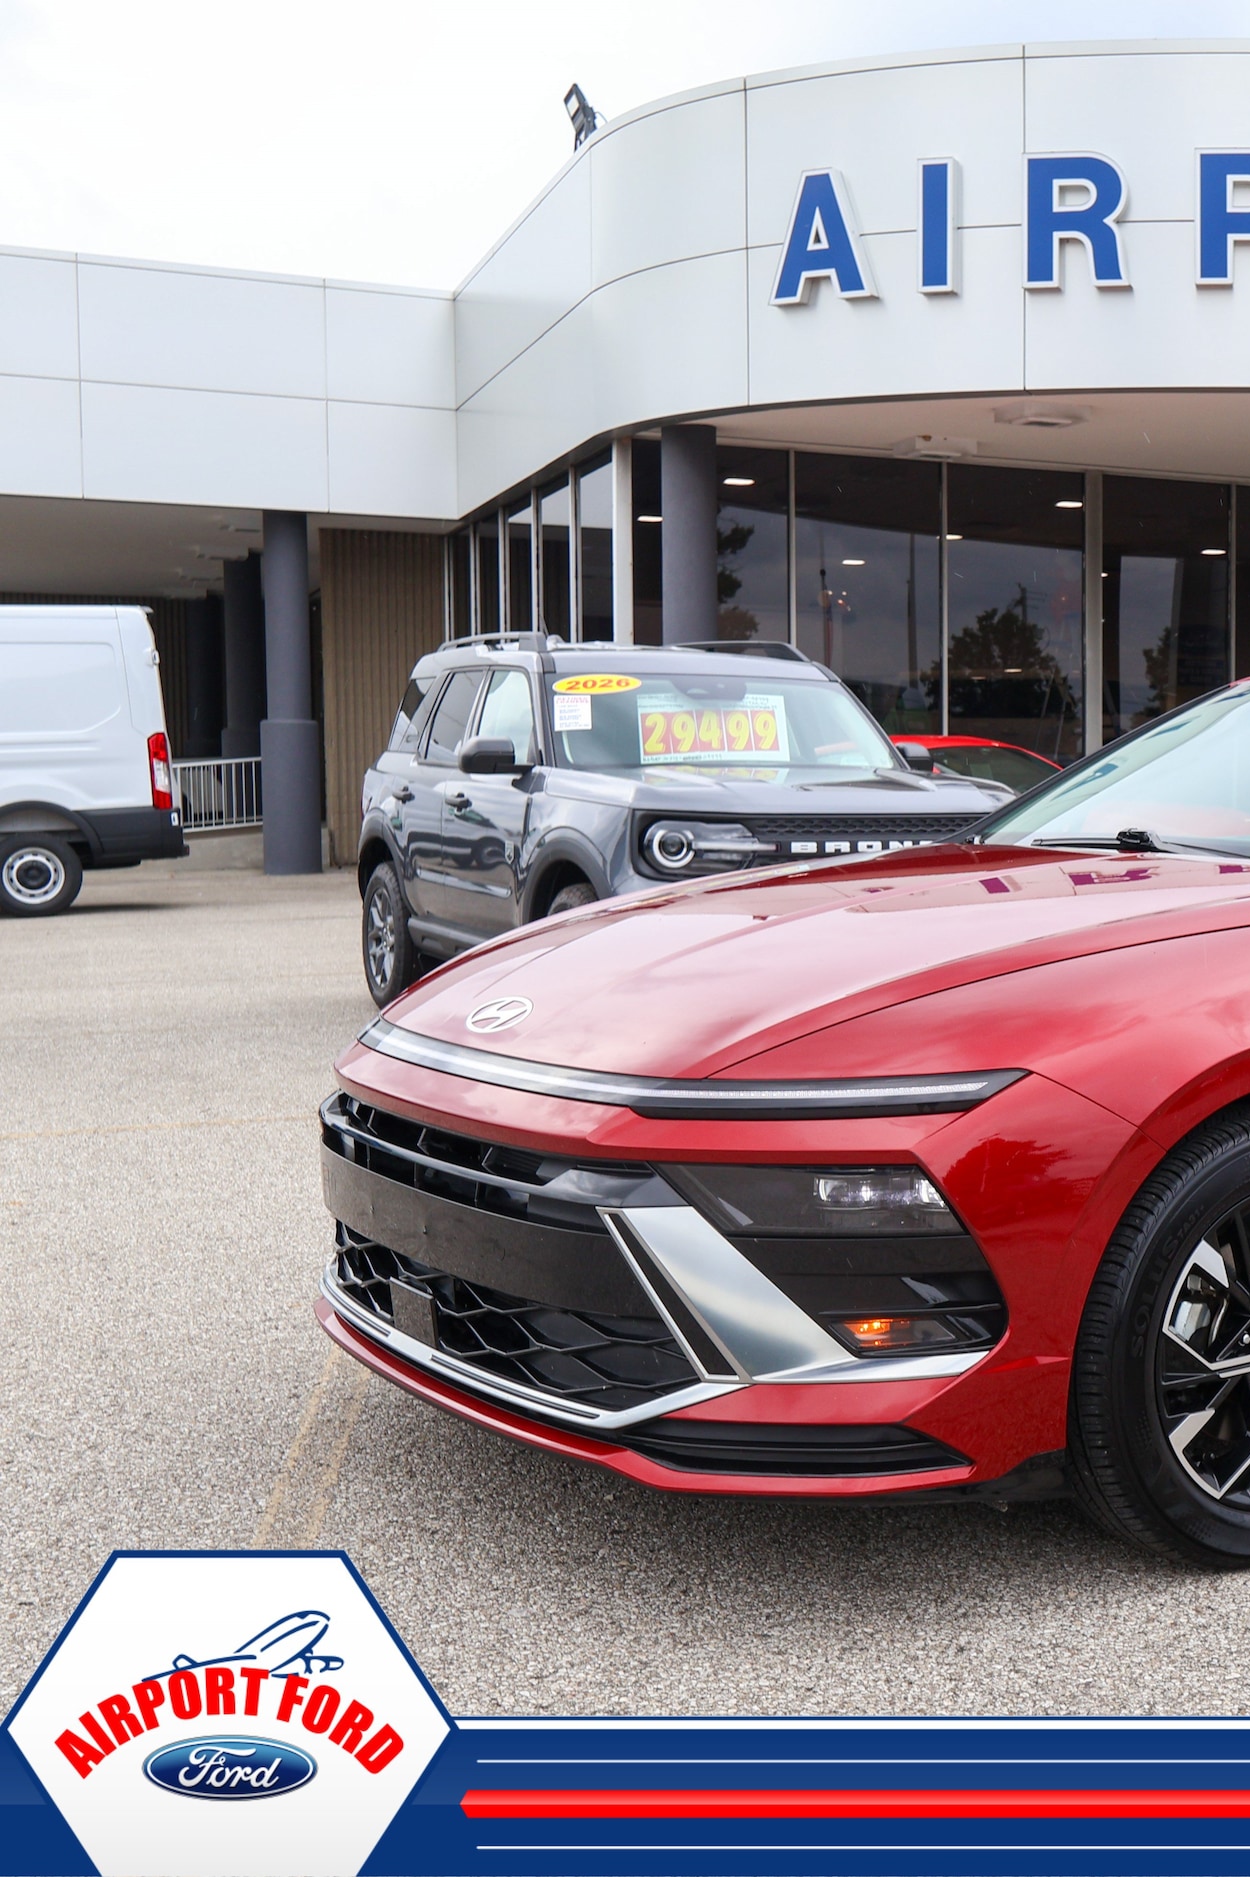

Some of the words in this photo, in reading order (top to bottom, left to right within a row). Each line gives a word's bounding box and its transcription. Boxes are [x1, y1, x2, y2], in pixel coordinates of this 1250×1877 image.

[565, 679, 631, 692] 2026
[644, 709, 778, 753] 29499
[790, 841, 935, 853] BRON
[1131, 1234, 1179, 1358] SOLUS
